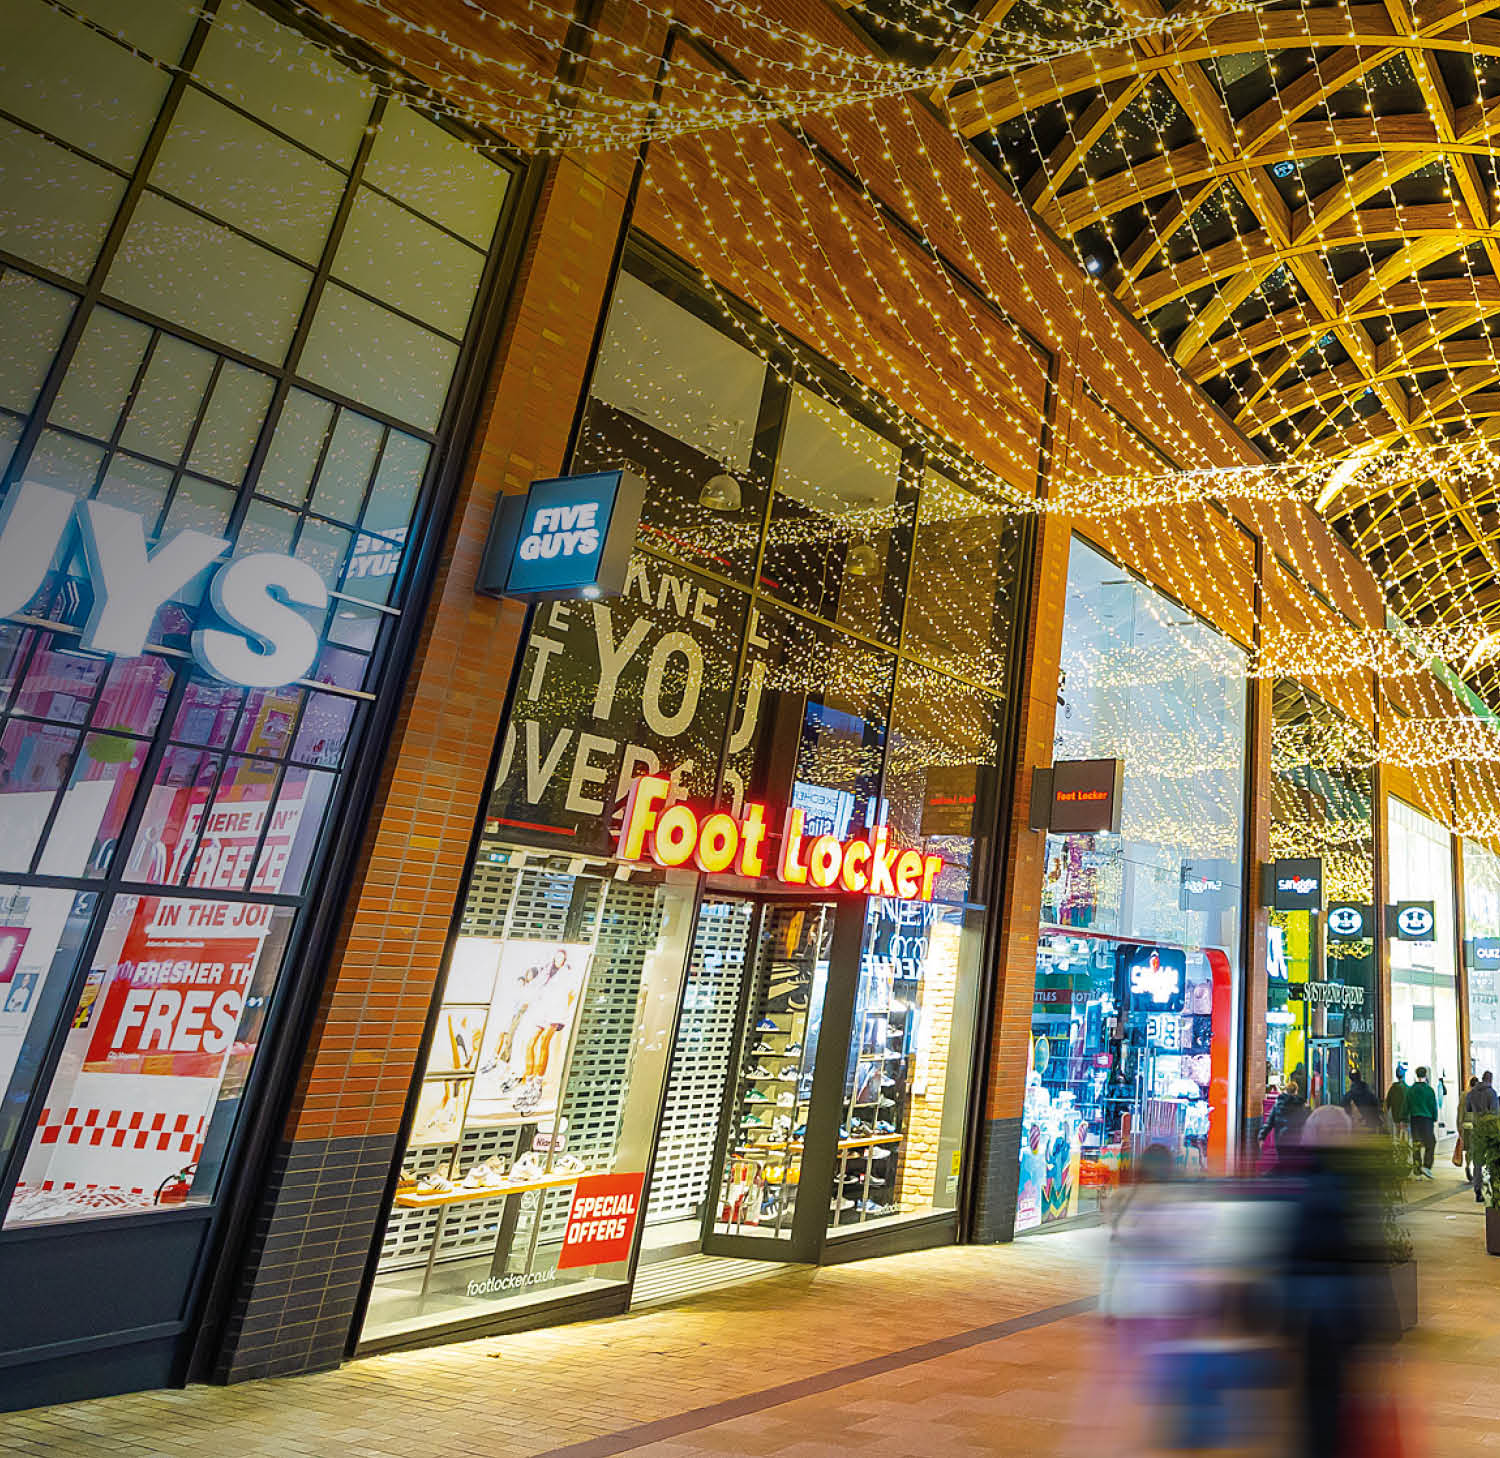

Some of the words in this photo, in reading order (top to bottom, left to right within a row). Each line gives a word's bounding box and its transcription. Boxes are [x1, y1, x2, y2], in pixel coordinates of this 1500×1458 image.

[532, 503, 599, 535] FIVE
[519, 529, 599, 561] GUYS
[619, 775, 767, 878] Foot
[778, 804, 945, 902] Locker
[157, 904, 182, 927] IN
[186, 904, 229, 928] THE
[1476, 948, 1500, 960] QUIZ
[132, 961, 225, 985] FRESHER
[572, 1194, 636, 1220] SPECIAL
[567, 1217, 628, 1245] OFFERS
[466, 1267, 558, 1297] footlocker.co.uk
